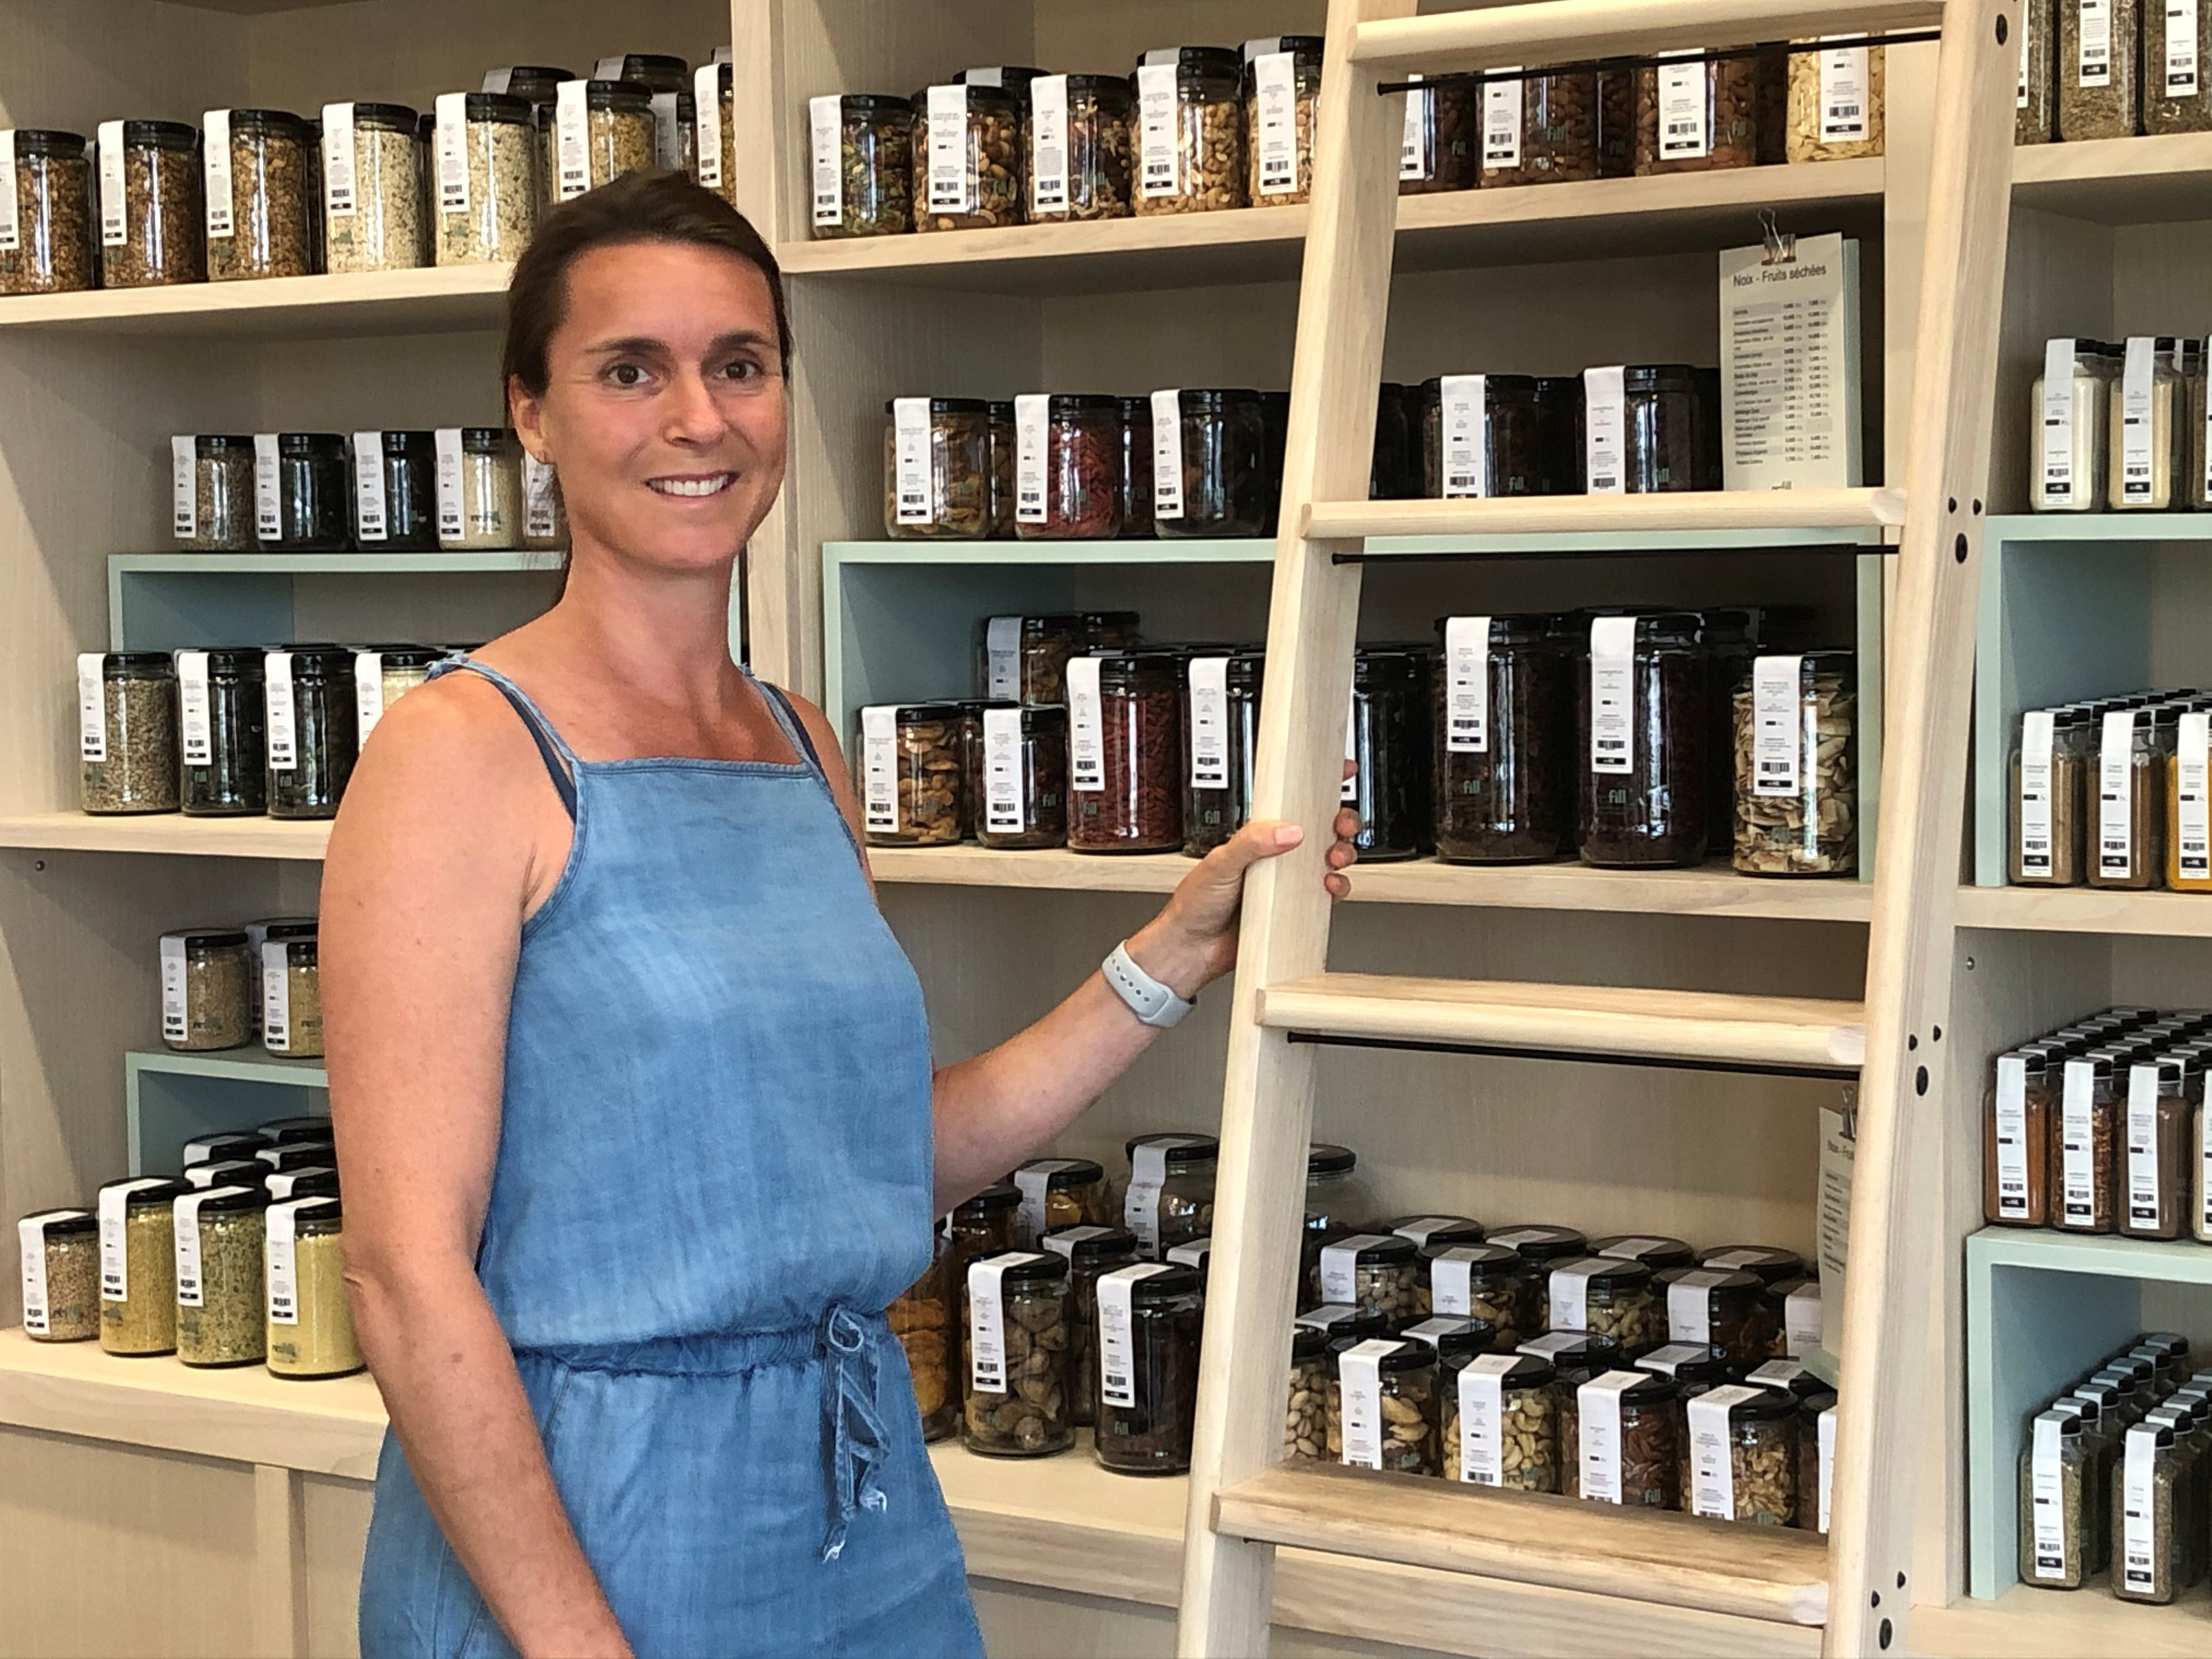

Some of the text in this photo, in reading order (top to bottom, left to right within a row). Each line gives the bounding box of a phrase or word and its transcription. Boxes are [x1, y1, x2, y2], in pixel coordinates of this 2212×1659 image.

[1733, 274, 1753, 287] Noix
[1762, 269, 1787, 283] Fruits
[1790, 264, 1826, 280] séchées
[1509, 476, 1525, 490] fill
[1463, 780, 1481, 794] fill
[1609, 789, 1626, 804] fill
[1205, 810, 1221, 824] fill
[1645, 1488, 1661, 1503] fill
